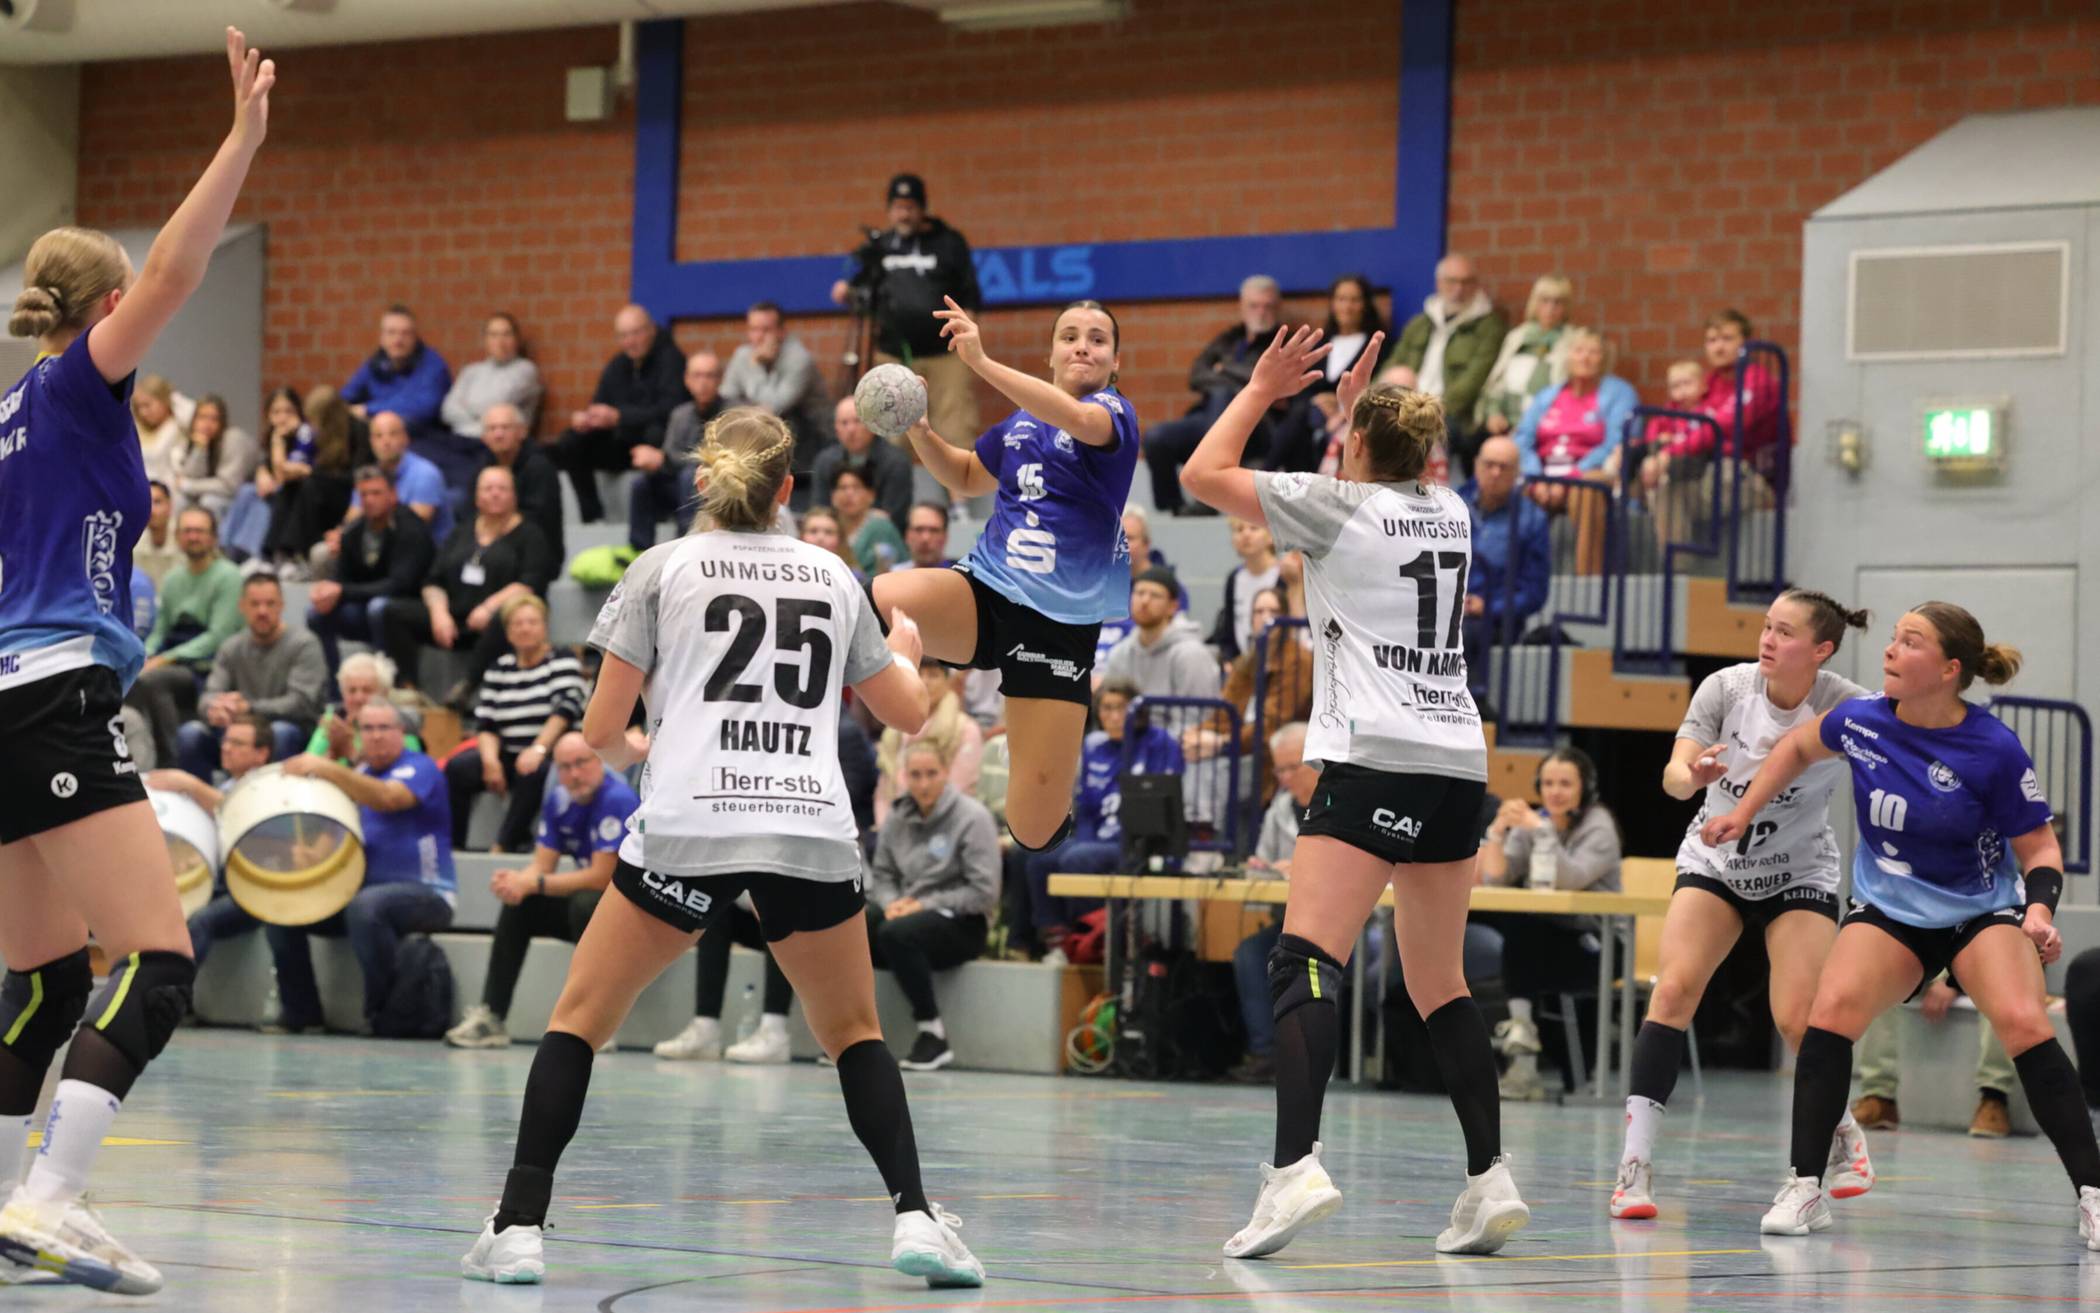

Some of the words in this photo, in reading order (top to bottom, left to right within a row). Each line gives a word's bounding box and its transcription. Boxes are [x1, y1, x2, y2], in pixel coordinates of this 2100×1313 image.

[1016, 463, 1048, 501] 15
[1399, 551, 1467, 649] 17
[703, 594, 832, 709] 25
[1372, 645, 1423, 673] VON
[720, 719, 812, 757] HAUTZ
[721, 767, 822, 795] herr-stb
[712, 801, 823, 817] steuerberater
[1869, 788, 1908, 832] 10
